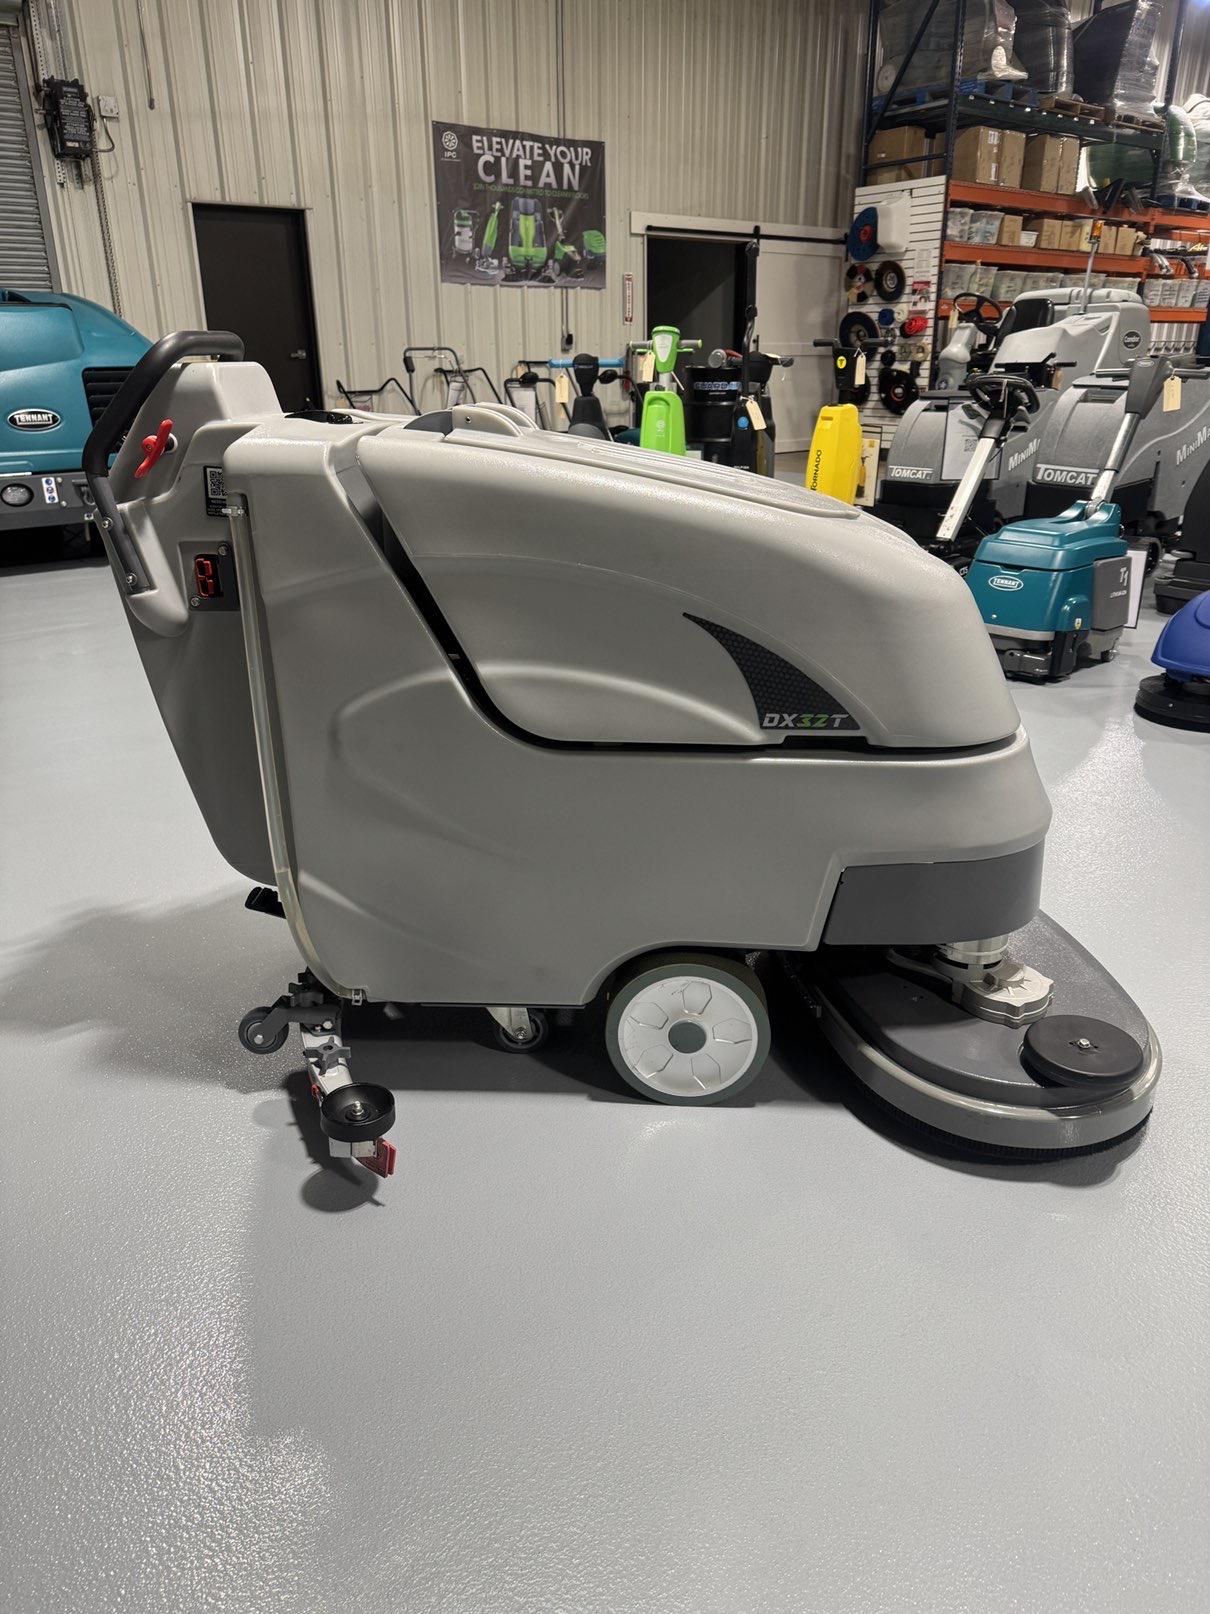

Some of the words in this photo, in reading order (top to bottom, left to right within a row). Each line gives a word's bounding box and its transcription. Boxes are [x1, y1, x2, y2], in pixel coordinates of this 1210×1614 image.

[444, 151, 457, 159] IPC
[472, 135, 544, 161] ELEVATE
[545, 144, 592, 166] YOUR
[477, 154, 580, 191] CLEAN
[14, 413, 53, 425] TENNANT
[810, 449, 822, 491] TORNADO
[888, 465, 934, 479] TOMCAT
[1036, 463, 1100, 485] TOMCAT
[993, 577, 1019, 588] TENNANT
[762, 713, 850, 728] DX32T
